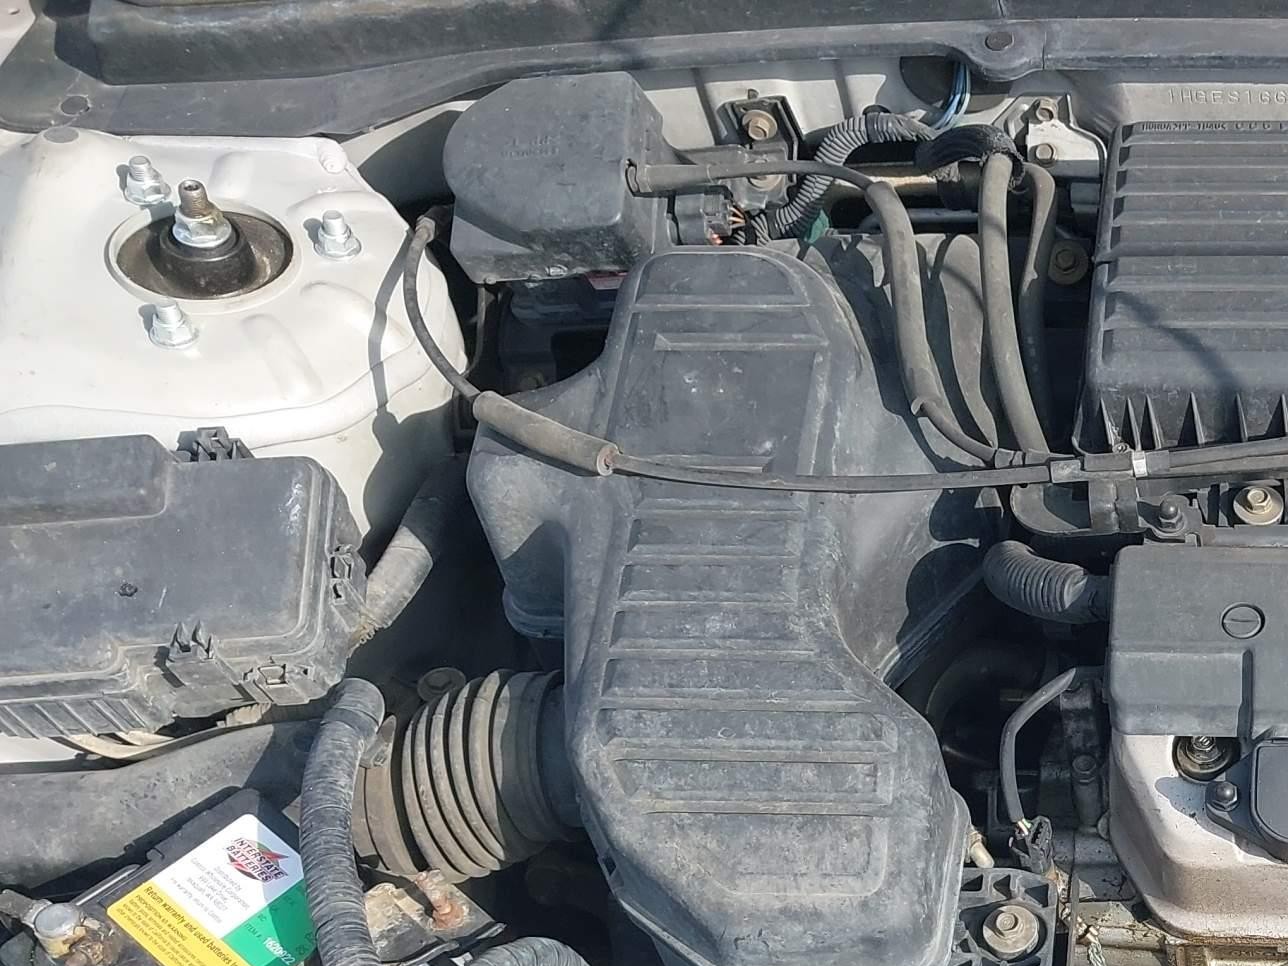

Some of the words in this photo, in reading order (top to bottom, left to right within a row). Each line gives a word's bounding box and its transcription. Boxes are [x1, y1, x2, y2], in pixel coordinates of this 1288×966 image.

[225, 843, 272, 883] BATTERIES
[232, 835, 285, 879] INTERSTATE
[143, 885, 166, 904] Return
[157, 900, 188, 925] warranty
[182, 920, 198, 933] and
[192, 928, 211, 944] used
[205, 940, 235, 965] batteries
[261, 936, 297, 966] 1620922
